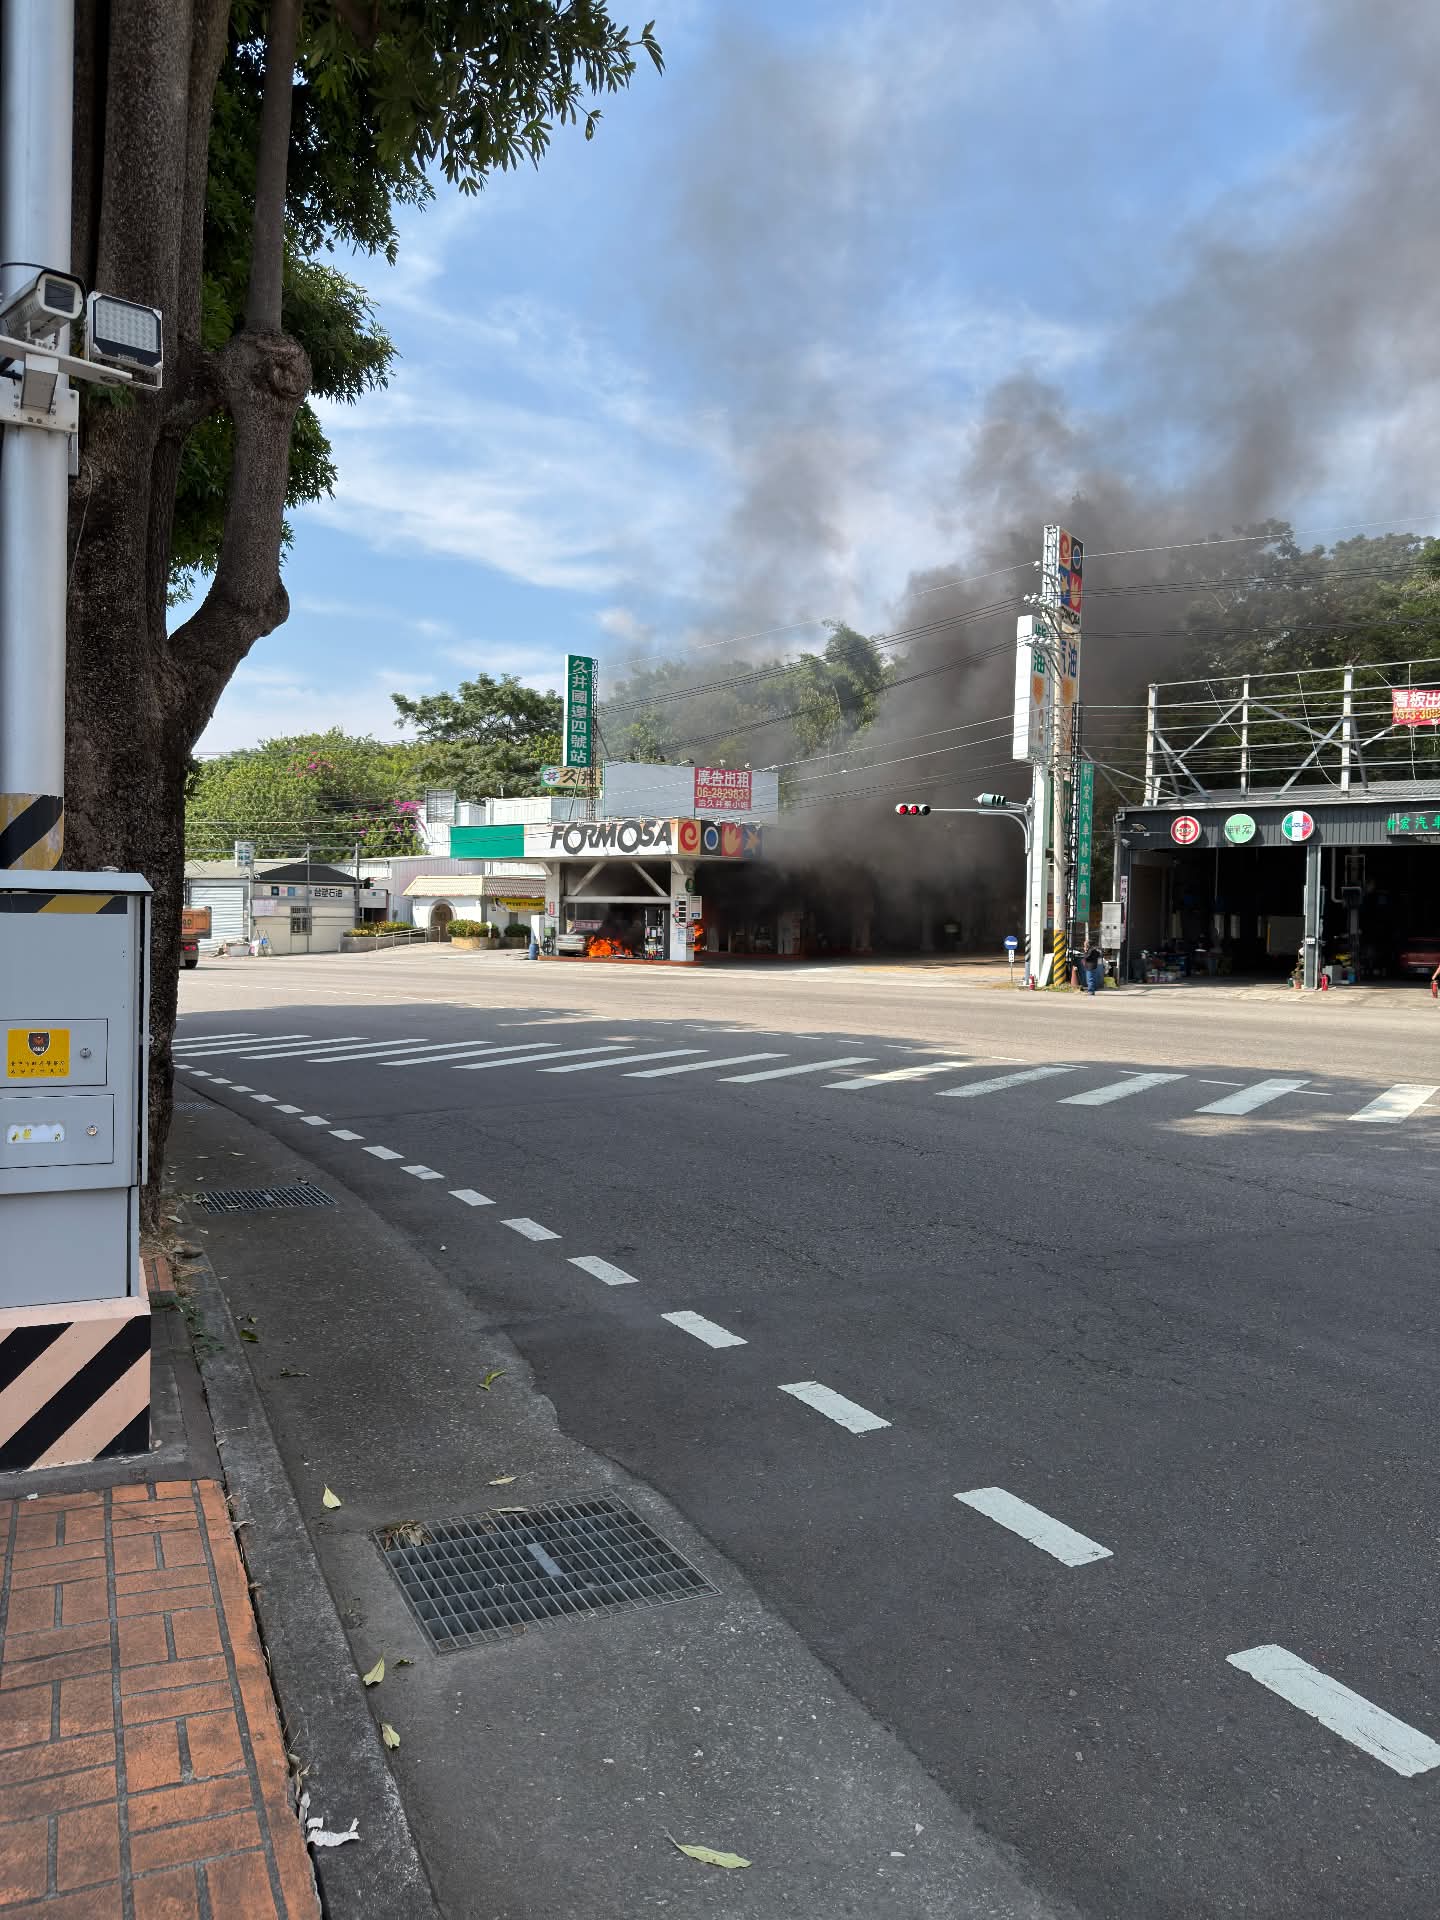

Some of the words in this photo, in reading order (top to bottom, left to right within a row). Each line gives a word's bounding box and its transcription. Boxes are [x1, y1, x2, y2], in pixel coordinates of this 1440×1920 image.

[697, 770, 750, 788] 廣告出租
[550, 820, 673, 855] FORMOSA
[314, 887, 343, 898] 台塑石油
